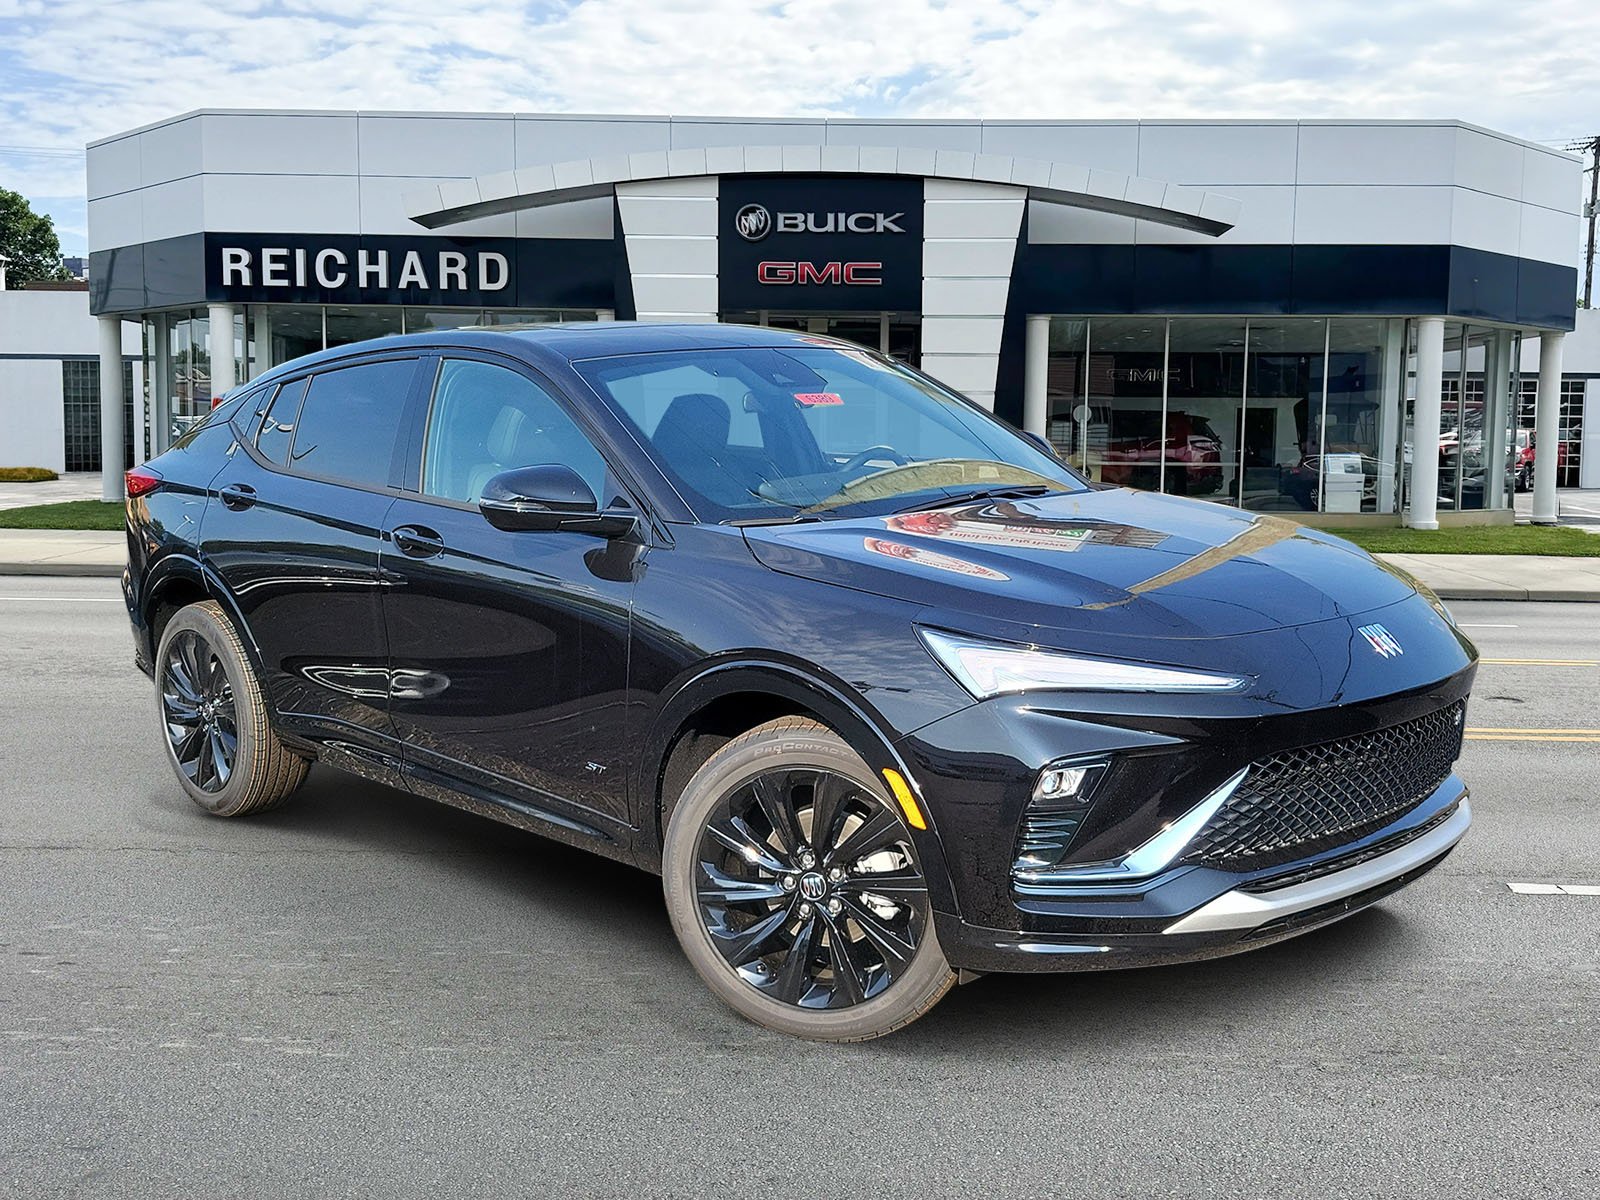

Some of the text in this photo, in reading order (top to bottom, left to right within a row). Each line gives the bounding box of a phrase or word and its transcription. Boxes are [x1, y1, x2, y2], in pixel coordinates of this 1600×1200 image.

[776, 212, 906, 233] BUICK
[222, 248, 510, 291] REICHARD
[758, 261, 882, 284] GMC
